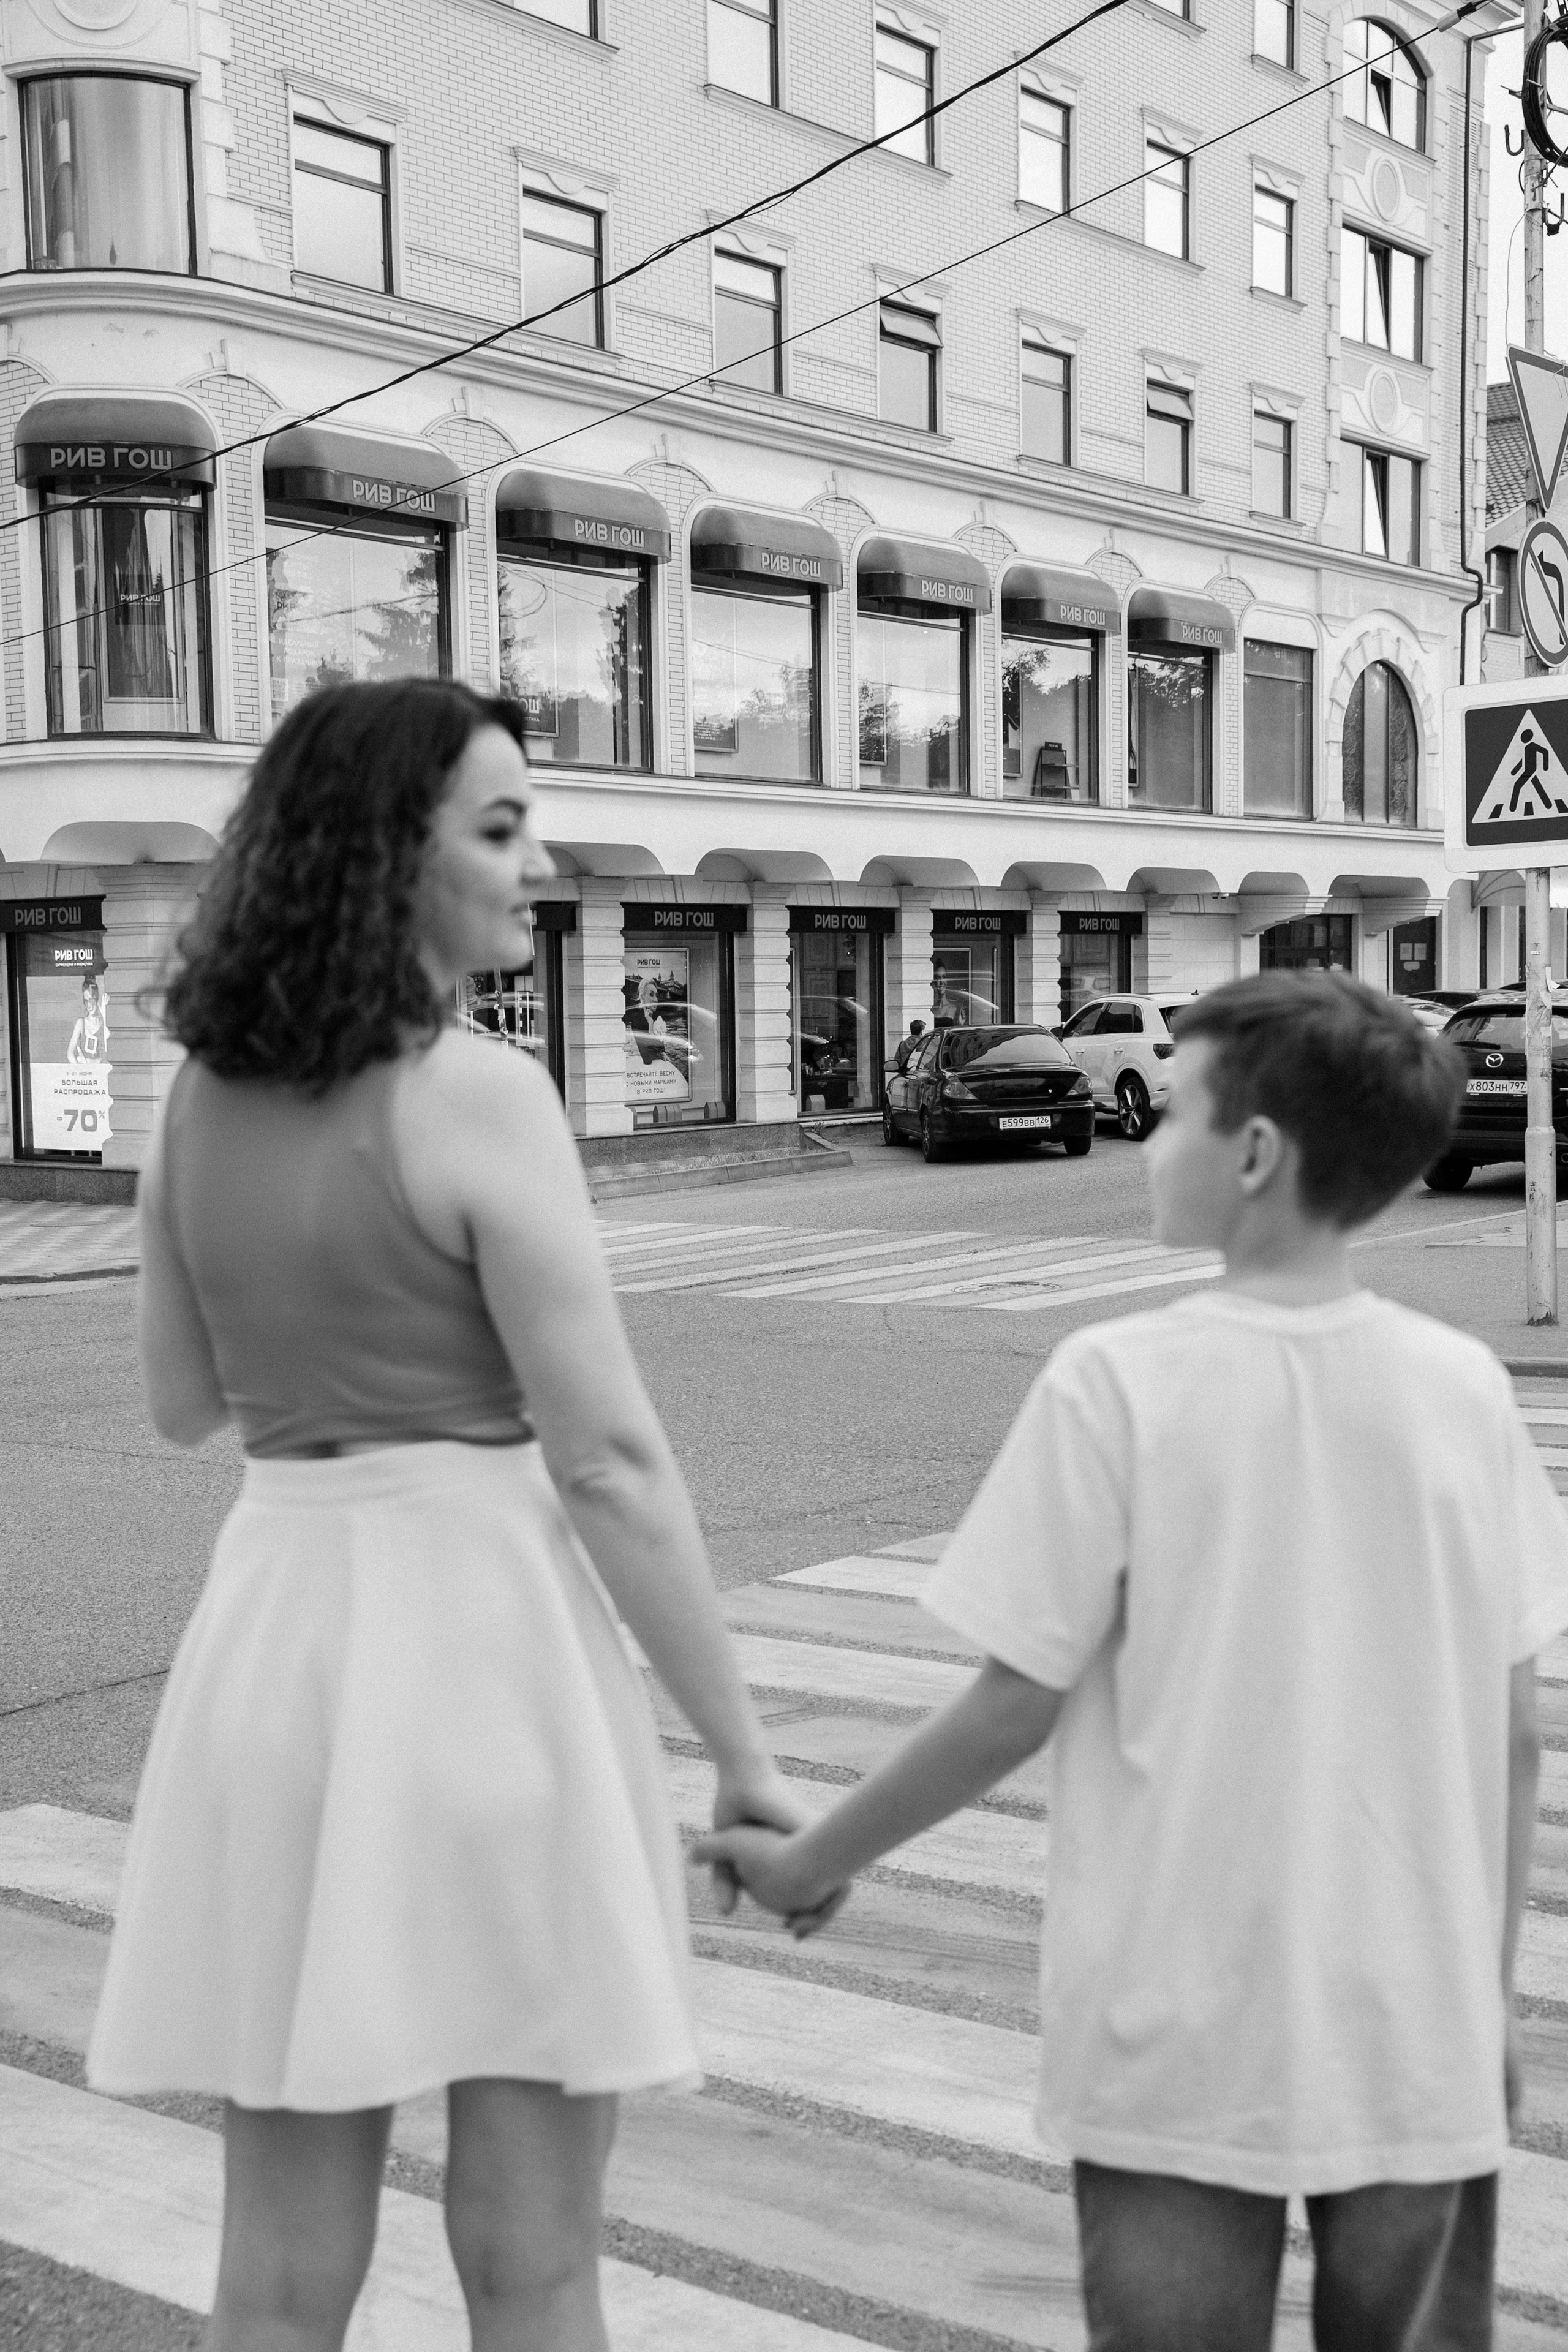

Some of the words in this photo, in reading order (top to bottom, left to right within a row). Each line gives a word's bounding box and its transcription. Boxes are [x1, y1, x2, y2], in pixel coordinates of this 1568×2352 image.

[51, 447, 105, 469] РИВ
[113, 447, 172, 470] ГОШ
[353, 480, 392, 505] РИВ
[396, 488, 435, 513] ГОШ
[575, 519, 608, 541] РИВ
[611, 526, 644, 548] ГОШ
[761, 552, 790, 573] РИВ
[793, 557, 821, 578] ГОШ
[921, 579, 946, 598] РИВ
[948, 584, 973, 603] ГОШ
[1060, 605, 1082, 622] РИВ
[1084, 609, 1106, 626] ГОШ
[1182, 625, 1202, 641] РИВ
[1203, 628, 1223, 644] ГОШ
[15, 908, 46, 926] РИВ
[49, 907, 81, 925] ГОШ
[655, 911, 683, 927] РИВ
[686, 911, 714, 927] ГОШ
[815, 914, 839, 929] РИВ
[842, 914, 866, 929] ГОШ
[956, 917, 977, 930] РИВ
[979, 917, 1001, 930] ГОШ
[1079, 918, 1098, 930] РИВ
[1100, 918, 1120, 930] ГОШ
[55, 949, 73, 961] РИВ
[74, 949, 93, 960] ГОШ
[1510, 1081, 1525, 1090] 797
